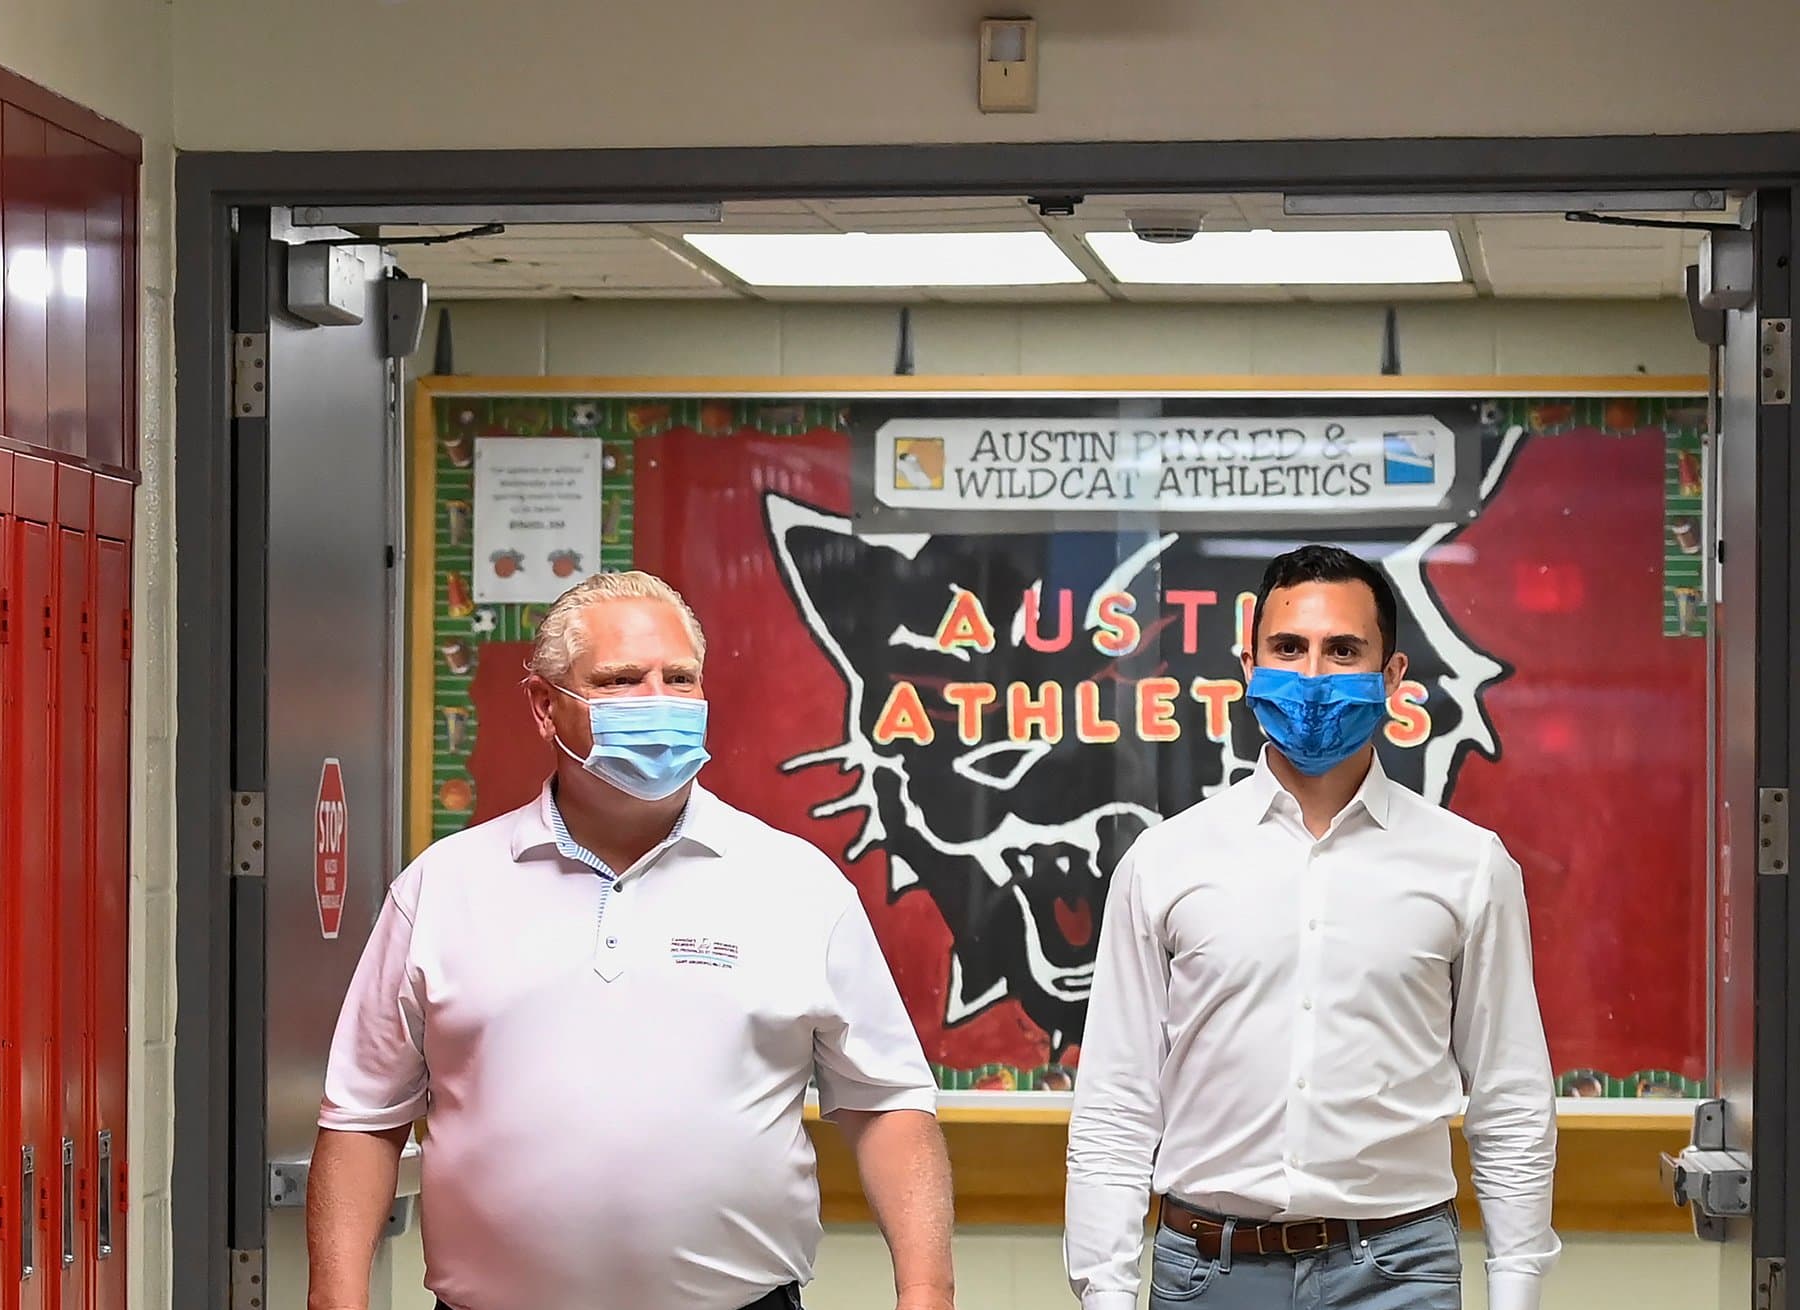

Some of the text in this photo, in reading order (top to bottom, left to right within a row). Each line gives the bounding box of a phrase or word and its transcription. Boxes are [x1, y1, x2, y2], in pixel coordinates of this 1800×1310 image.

[969, 429, 1119, 463] AUSTIN
[1321, 423, 1358, 460] &
[954, 463, 1372, 499] WILDCAT ATHLETICS
[936, 588, 1258, 658] AUSTI
[872, 676, 1432, 748] ATHLETS
[319, 801, 343, 853] STOP
